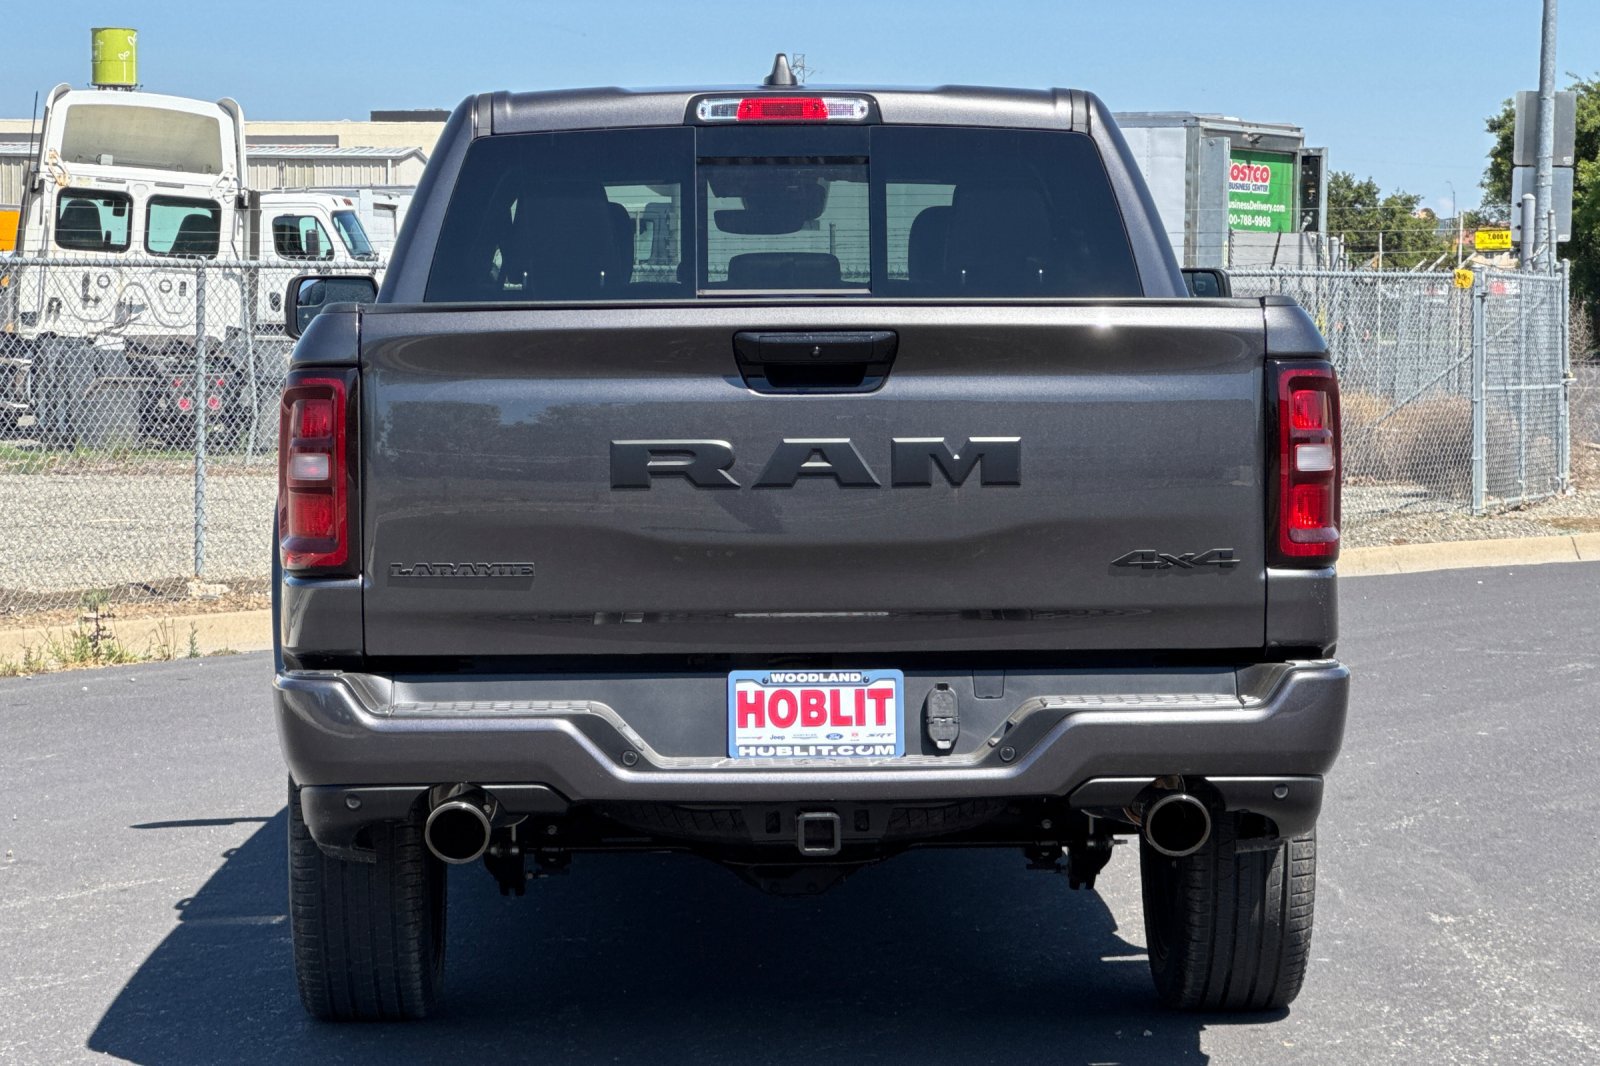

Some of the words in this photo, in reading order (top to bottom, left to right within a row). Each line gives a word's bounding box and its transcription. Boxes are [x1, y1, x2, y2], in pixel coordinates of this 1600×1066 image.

[1230, 164, 1270, 183] OSTCO
[1252, 184, 1269, 192] CENTER
[1228, 200, 1286, 213] usinessDelivery.com
[1229, 214, 1271, 227] 00-788-9968
[610, 437, 1021, 489] RAM
[390, 562, 535, 577] LARAMIE
[770, 672, 861, 683] WOODLAND
[737, 688, 894, 728] HOBLIT
[738, 745, 895, 757] HOBLIT.COM
